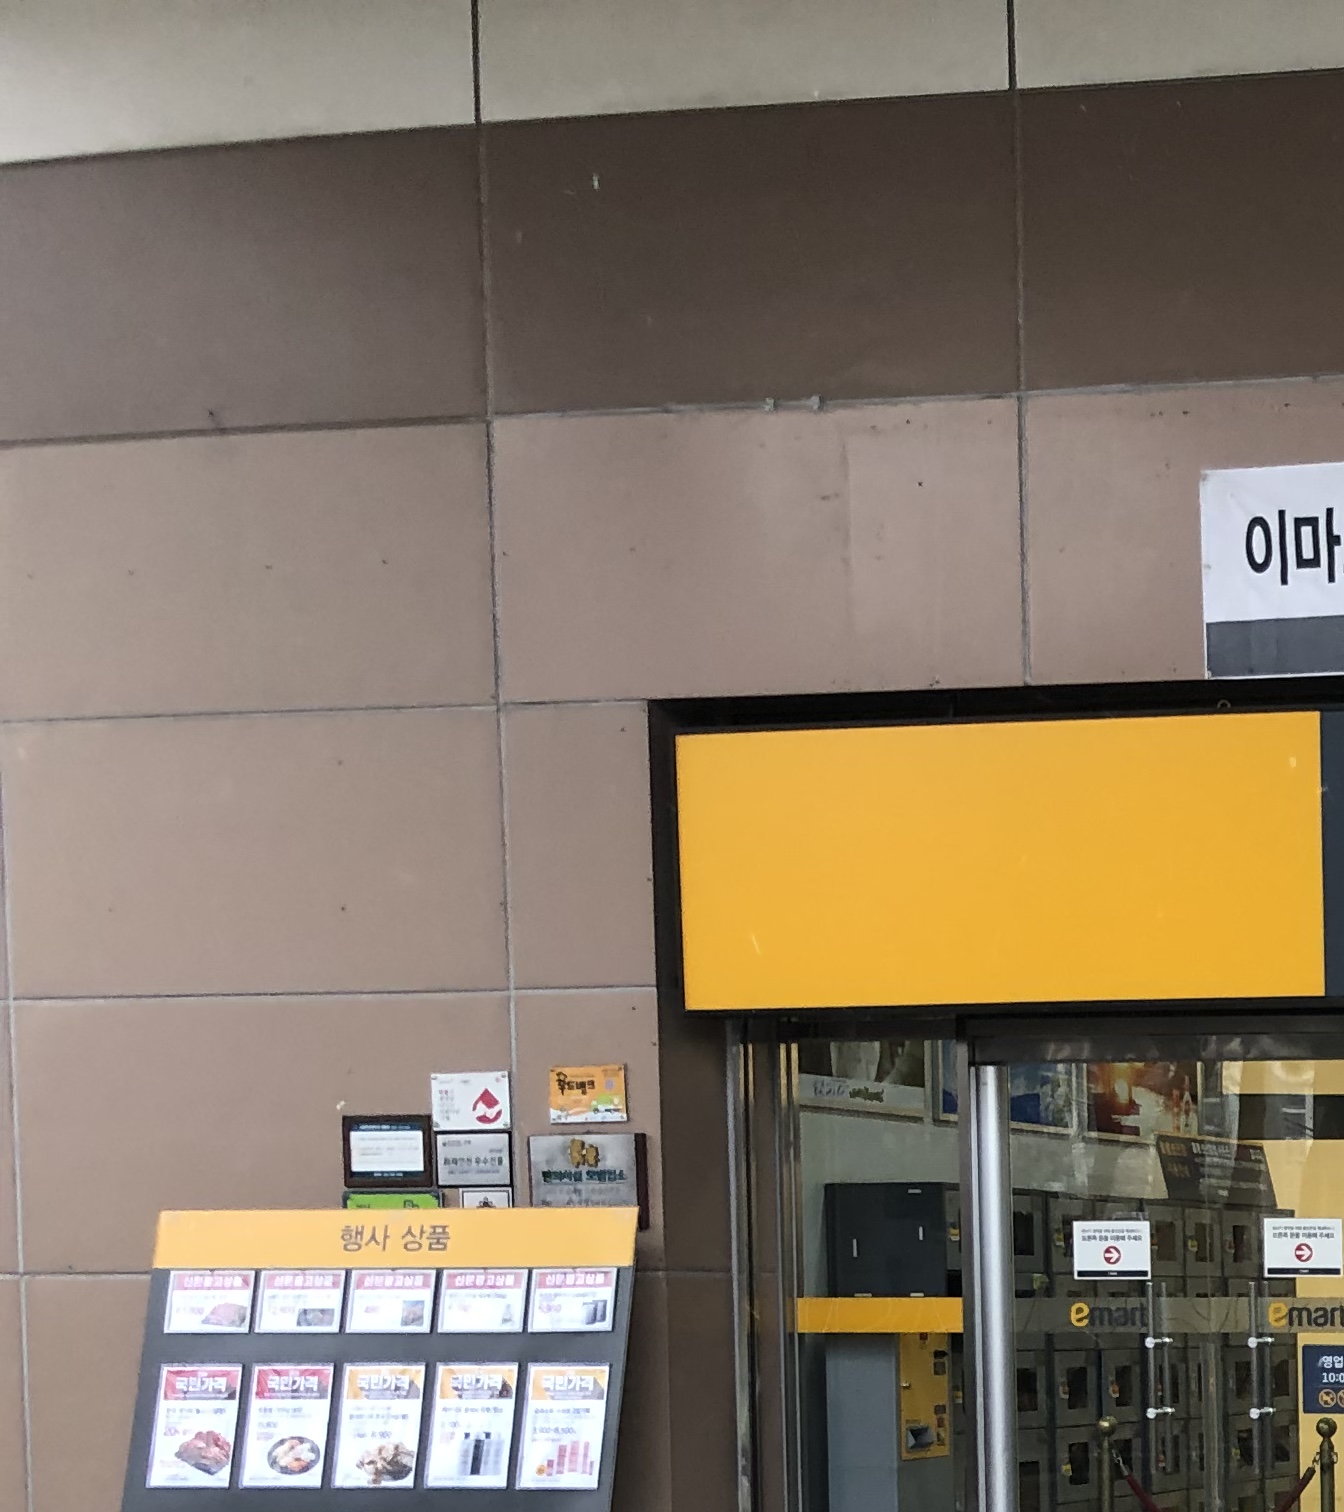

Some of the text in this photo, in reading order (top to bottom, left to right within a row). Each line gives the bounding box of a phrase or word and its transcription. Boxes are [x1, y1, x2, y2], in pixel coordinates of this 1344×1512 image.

[340, 1224, 452, 1252] 행사 상품
[1069, 1302, 1151, 1328] emart
[175, 1376, 228, 1392] 국민가격
[267, 1376, 319, 1392] 국민가격
[357, 1375, 410, 1391] 국민가격
[450, 1375, 504, 1390] 국민가격
[541, 1375, 595, 1391] 국민가격
